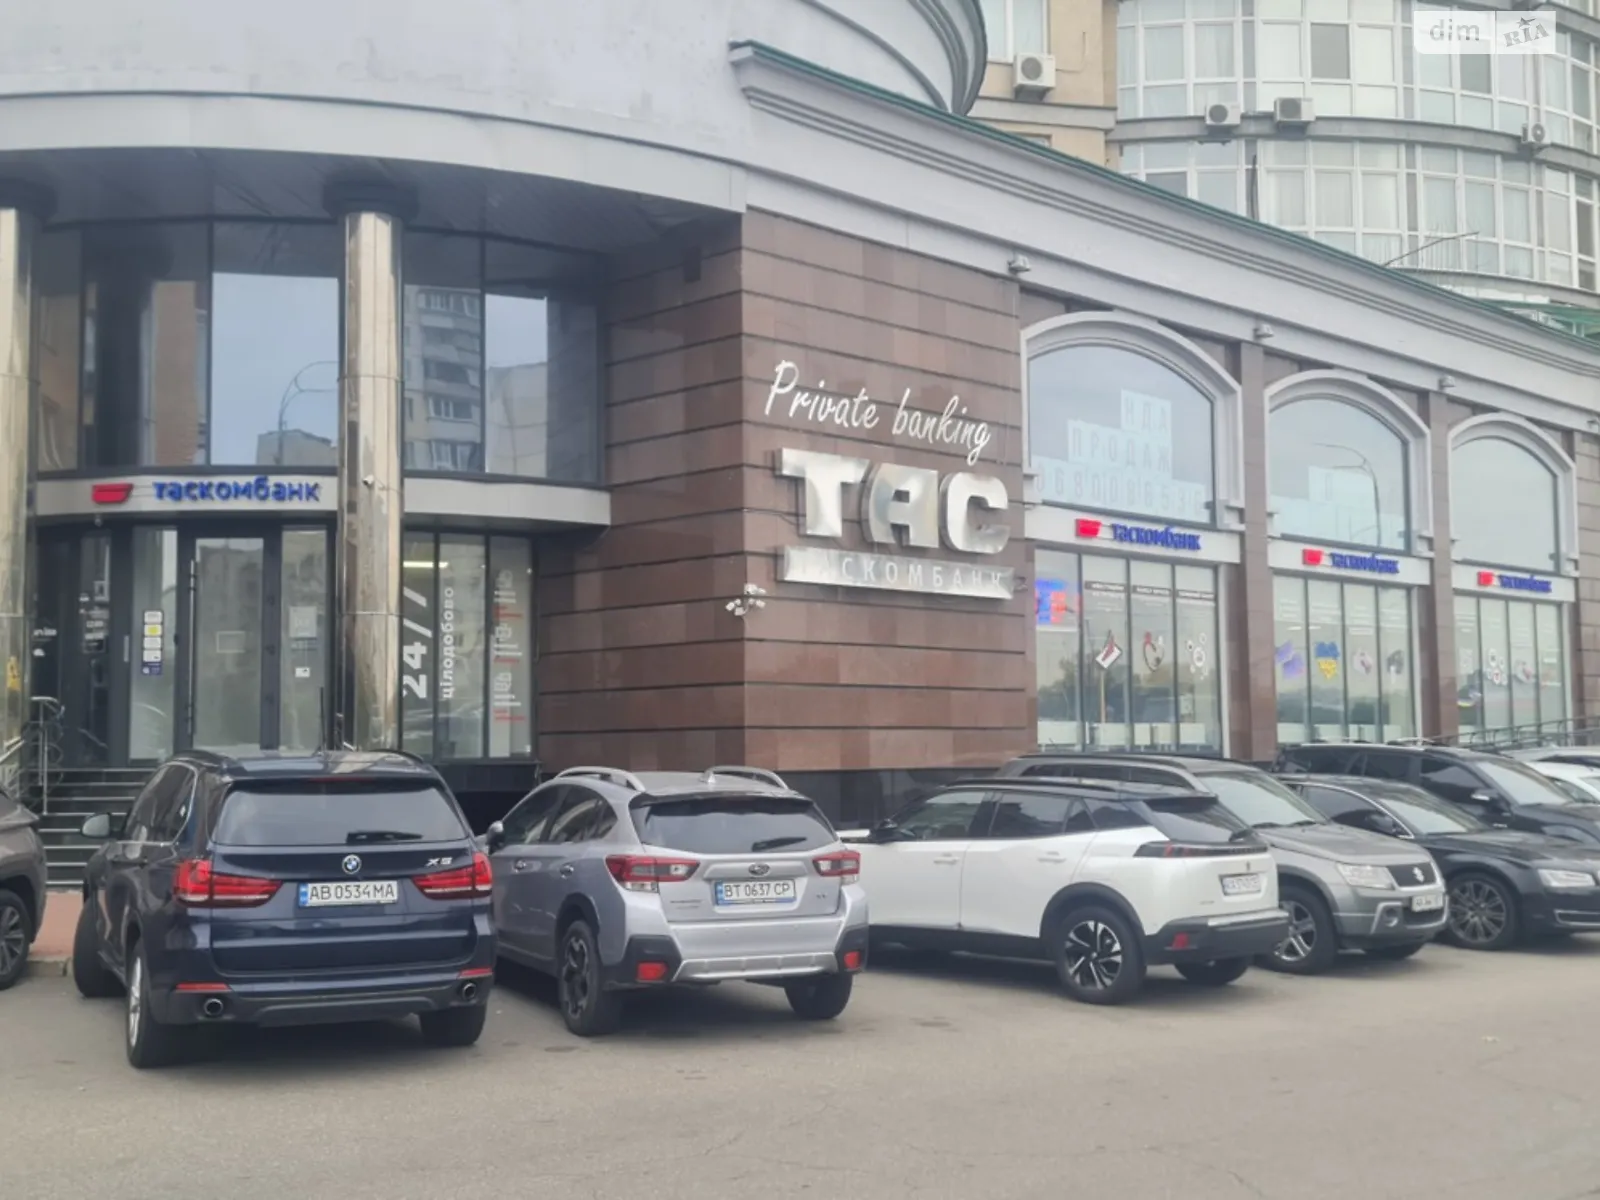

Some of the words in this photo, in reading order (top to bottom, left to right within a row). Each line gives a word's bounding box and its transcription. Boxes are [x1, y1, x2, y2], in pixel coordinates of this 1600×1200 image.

[764, 360, 879, 429] Private
[892, 388, 991, 466] banking
[153, 475, 321, 502] таскомбанк
[1112, 524, 1201, 550] таскомбанк
[797, 553, 1002, 588] СКОМБАНК
[440, 586, 456, 699] цілодобово
